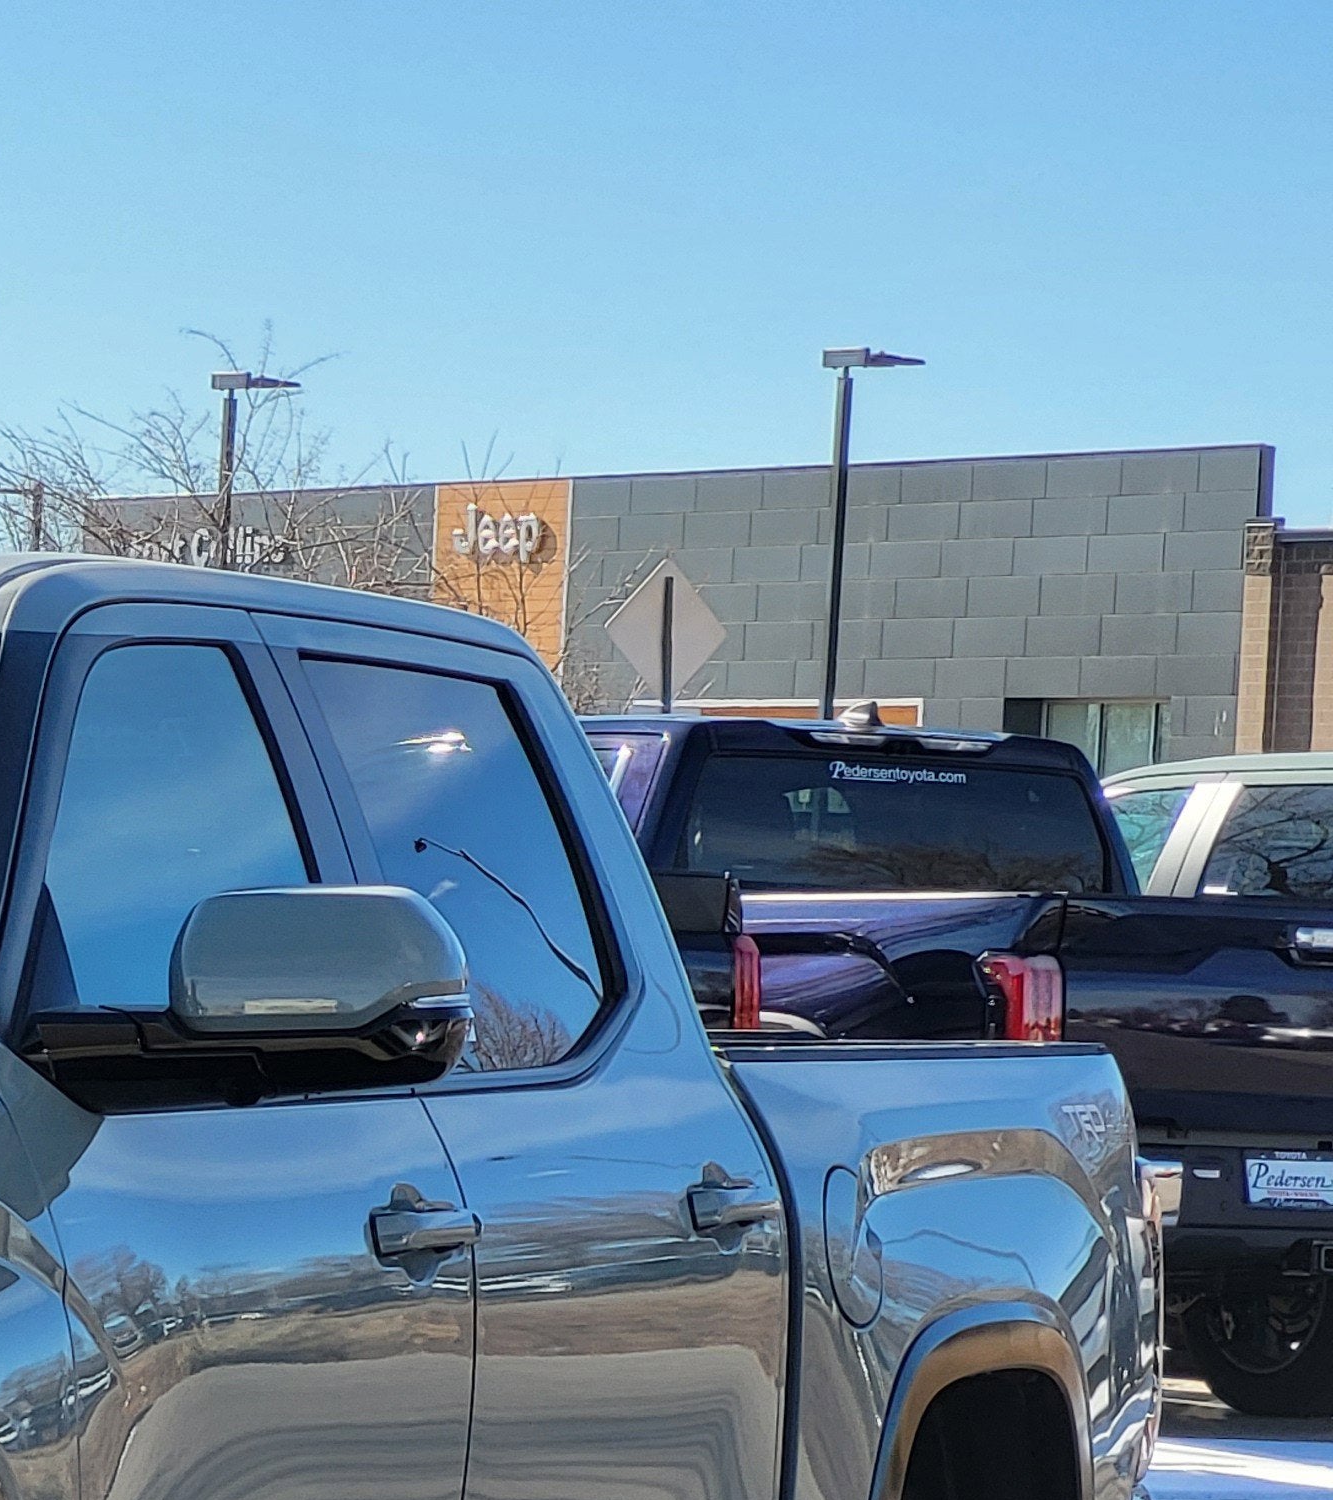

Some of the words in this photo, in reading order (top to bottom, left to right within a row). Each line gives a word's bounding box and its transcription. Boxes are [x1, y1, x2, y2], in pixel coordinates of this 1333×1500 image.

[452, 503, 540, 563] Jeep
[829, 761, 967, 784] Pedersentoyota.com
[1249, 1163, 1333, 1189] Pedersen
